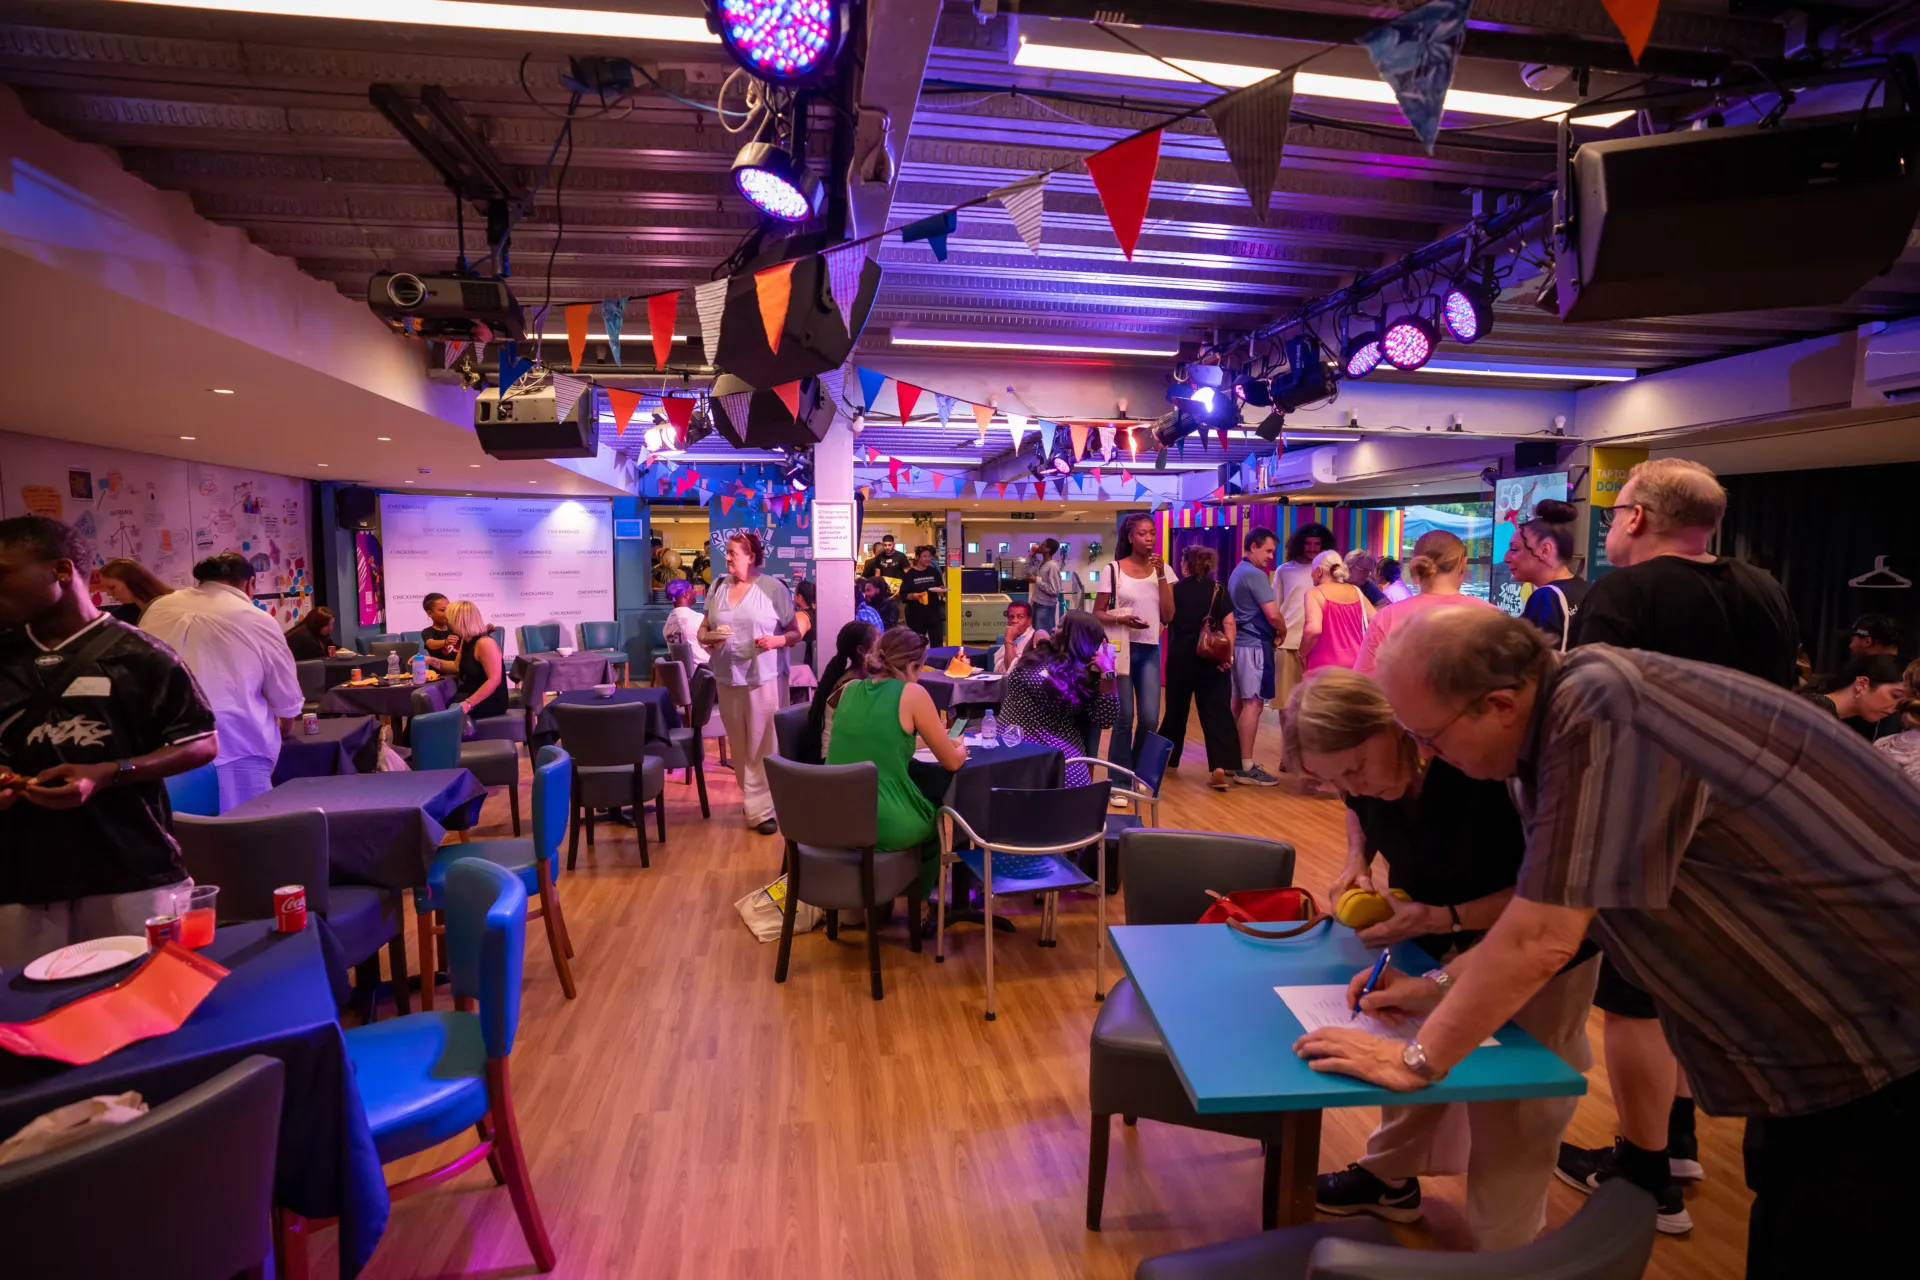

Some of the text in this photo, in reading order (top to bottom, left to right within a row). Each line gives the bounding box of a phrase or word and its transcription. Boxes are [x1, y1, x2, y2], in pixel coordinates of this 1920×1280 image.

[1596, 469, 1625, 479] TAP TO
[1596, 480, 1623, 492] DON
[109, 508, 133, 517] OUTREACH
